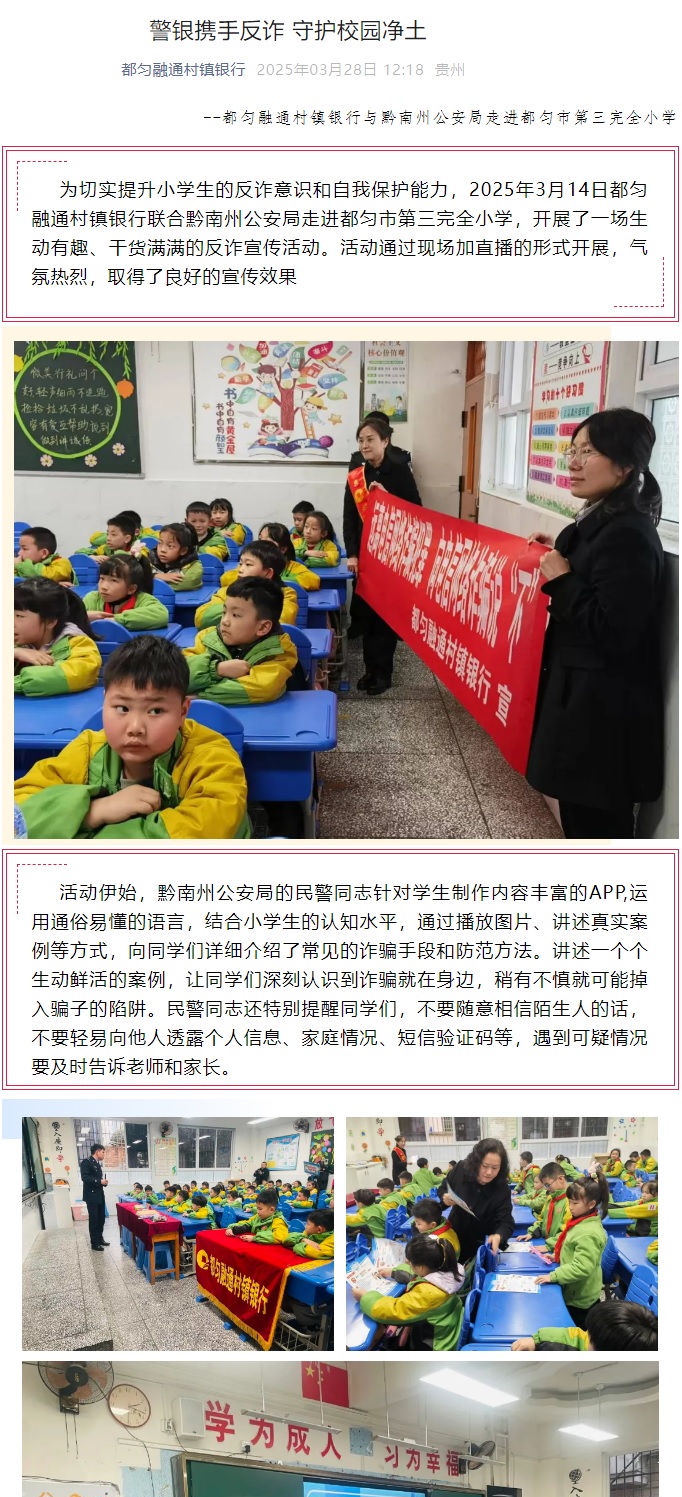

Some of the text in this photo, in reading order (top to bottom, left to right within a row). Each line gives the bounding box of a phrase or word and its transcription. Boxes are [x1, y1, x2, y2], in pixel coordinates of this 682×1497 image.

[215, 402, 226, 455] 书中自有颜如玉
[224, 387, 237, 455] 书中自有黄金屋
[411, 603, 513, 728] 都匀融通村镇银行 宣
[210, 1254, 269, 1315] 都匀融通村镇银行
[205, 1400, 461, 1477] 学为成人 习为幸福
